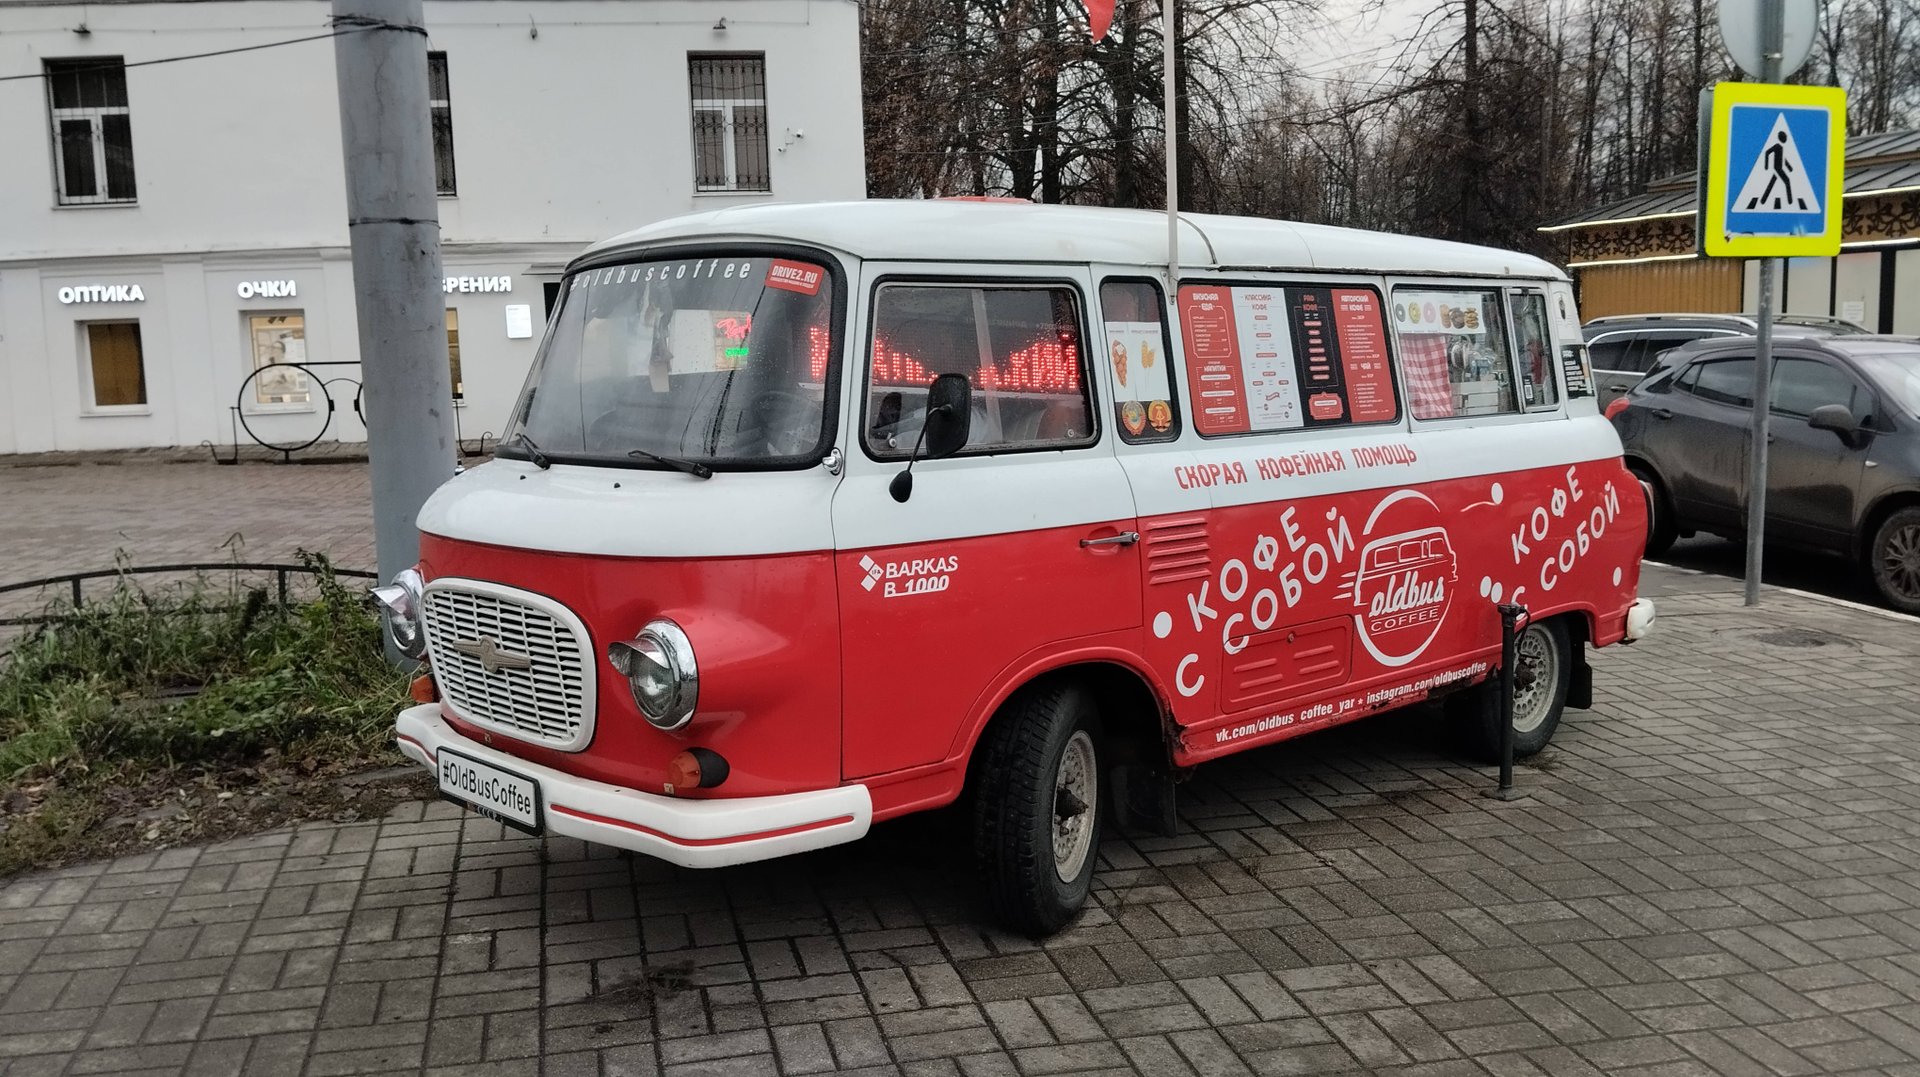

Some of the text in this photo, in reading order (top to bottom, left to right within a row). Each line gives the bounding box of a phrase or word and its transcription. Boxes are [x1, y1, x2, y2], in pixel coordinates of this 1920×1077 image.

[58, 284, 145, 304] ОПТИКА
[237, 280, 297, 299] ОЧКИ
[570, 259, 751, 291] #oldbuscoffee
[771, 265, 818, 284] DRIVE2.RU
[1174, 444, 1417, 490] СКОРАЯ КОФЕЙНАЯ ПОМОЩЬ
[1512, 465, 1584, 565] КОФЕ
[1540, 480, 1621, 591] СОБОЙ
[884, 575, 950, 598] B 1000
[885, 556, 959, 579] BARKAS
[1187, 506, 1307, 632] КОФЕ
[1175, 506, 1355, 697] С СОБОЙ
[1368, 571, 1444, 618] oldbus
[1370, 608, 1439, 632] COFFEE
[1367, 662, 1487, 704] instagram.com/oldbuscoffee
[443, 760, 531, 815] #OldBusCoffee
